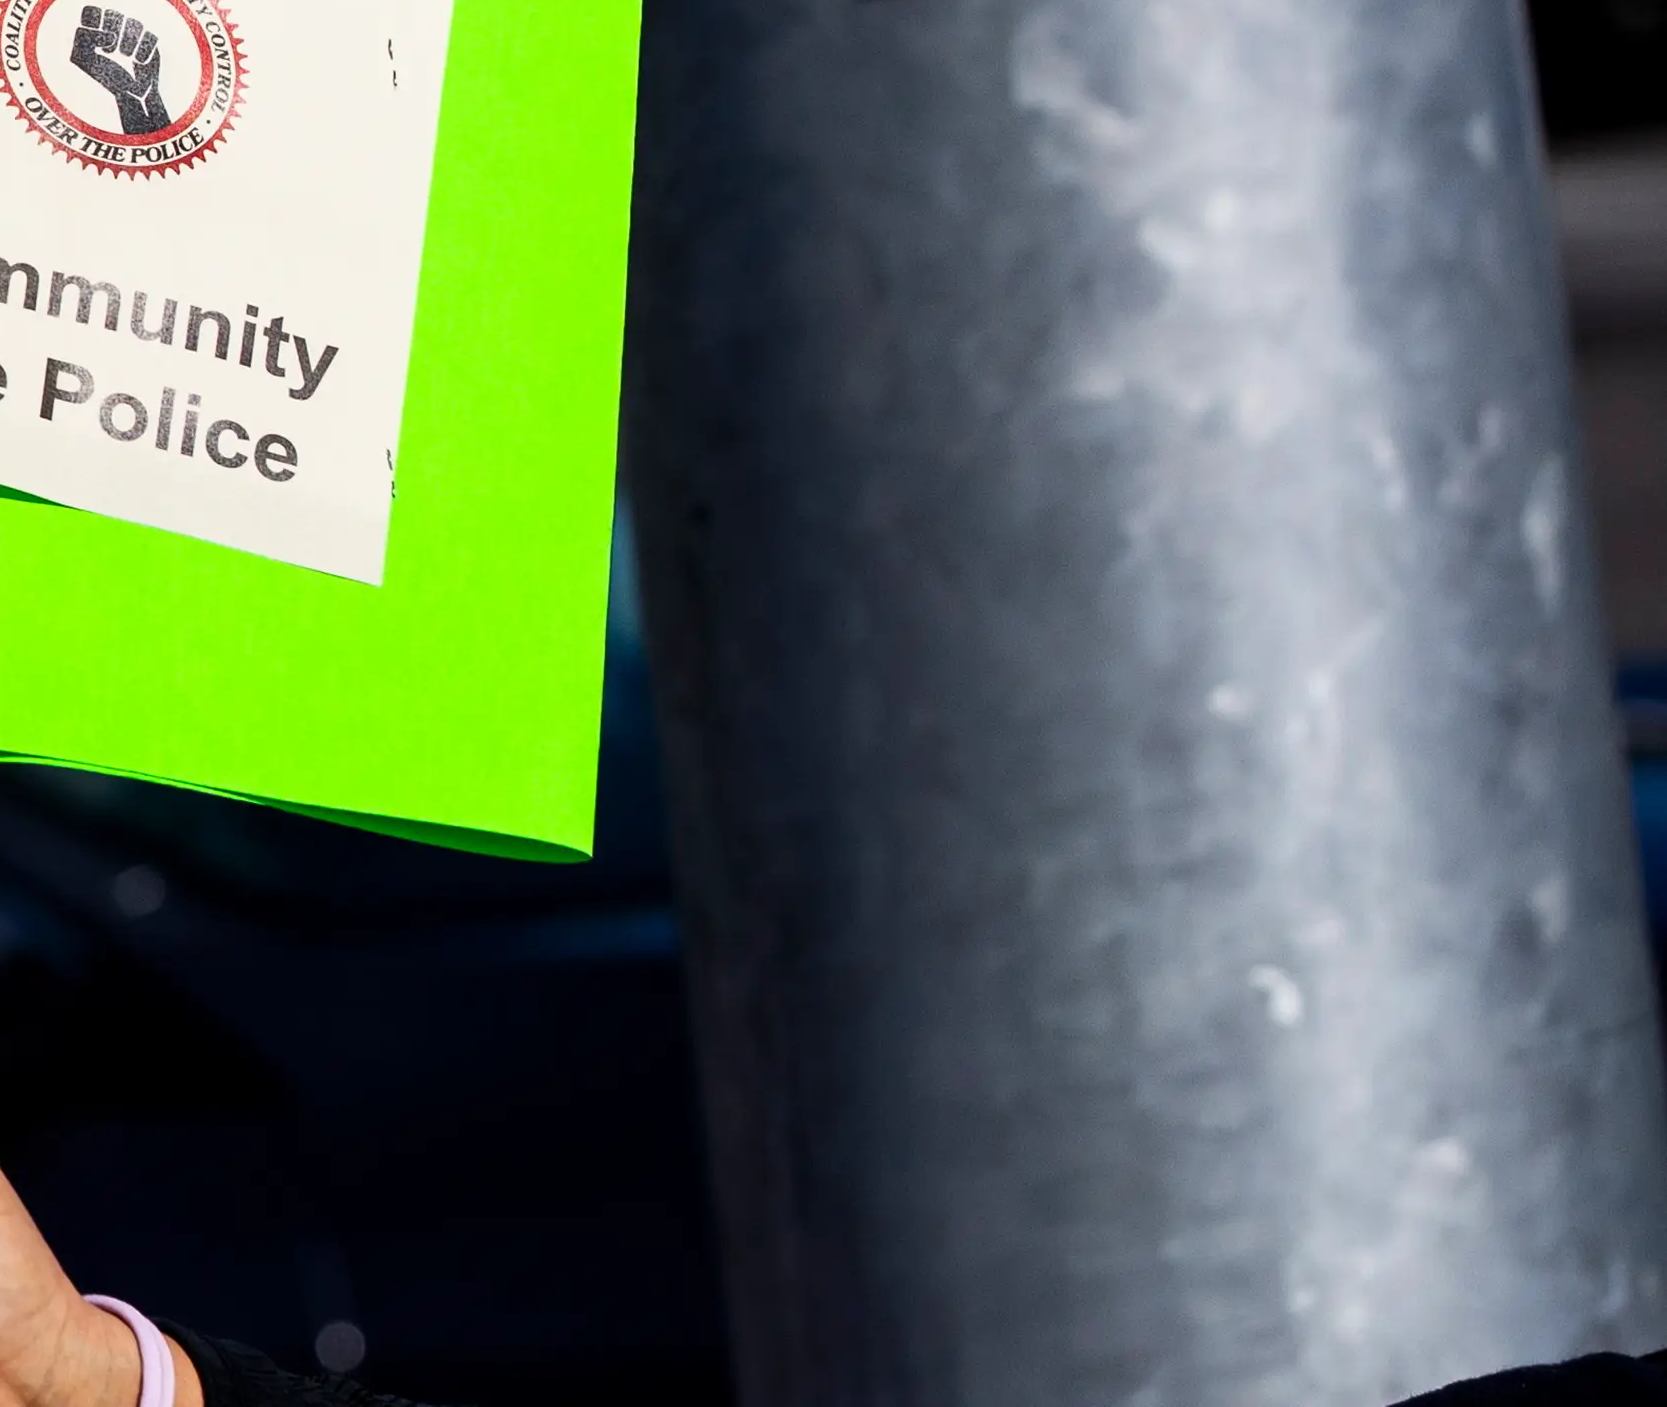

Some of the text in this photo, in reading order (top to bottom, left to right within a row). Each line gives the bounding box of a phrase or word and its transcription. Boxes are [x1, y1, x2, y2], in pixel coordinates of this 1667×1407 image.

[205, 20, 232, 112] CONTROL
[24, 96, 204, 164] OVER THE POLICE
[38, 356, 299, 483] Police
